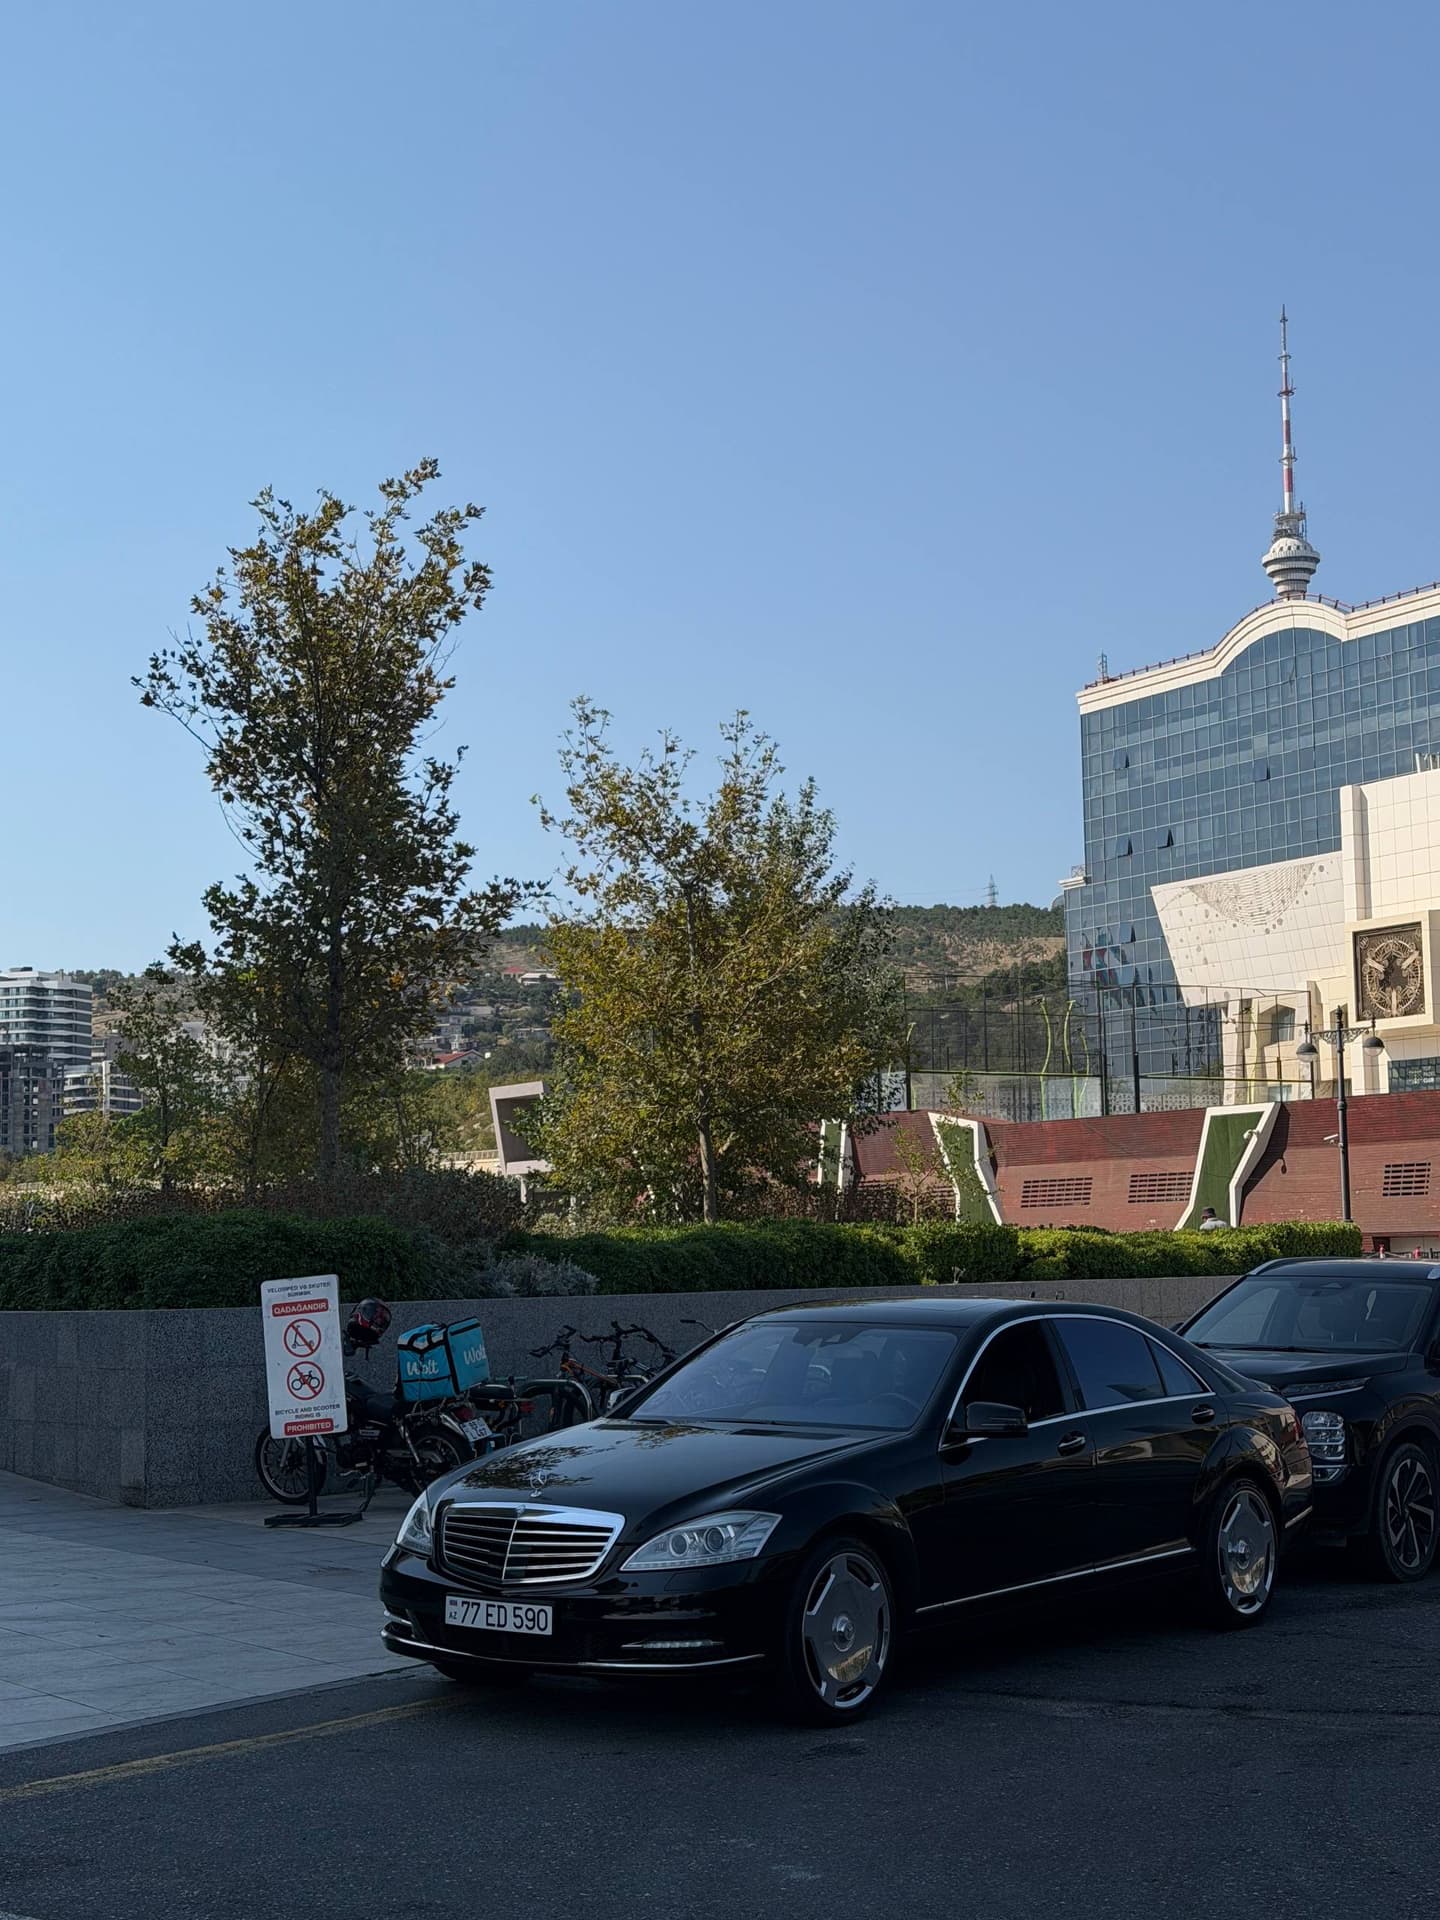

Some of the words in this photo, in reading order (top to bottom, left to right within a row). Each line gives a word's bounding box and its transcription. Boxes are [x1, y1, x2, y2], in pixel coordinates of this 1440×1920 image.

[406, 1359, 439, 1376] Wolt
[275, 1408, 299, 1416] BICYCLE
[287, 1421, 331, 1433] PROHIBITED
[461, 1601, 480, 1625] 77
[486, 1603, 507, 1628] ED
[513, 1606, 548, 1631] 590
